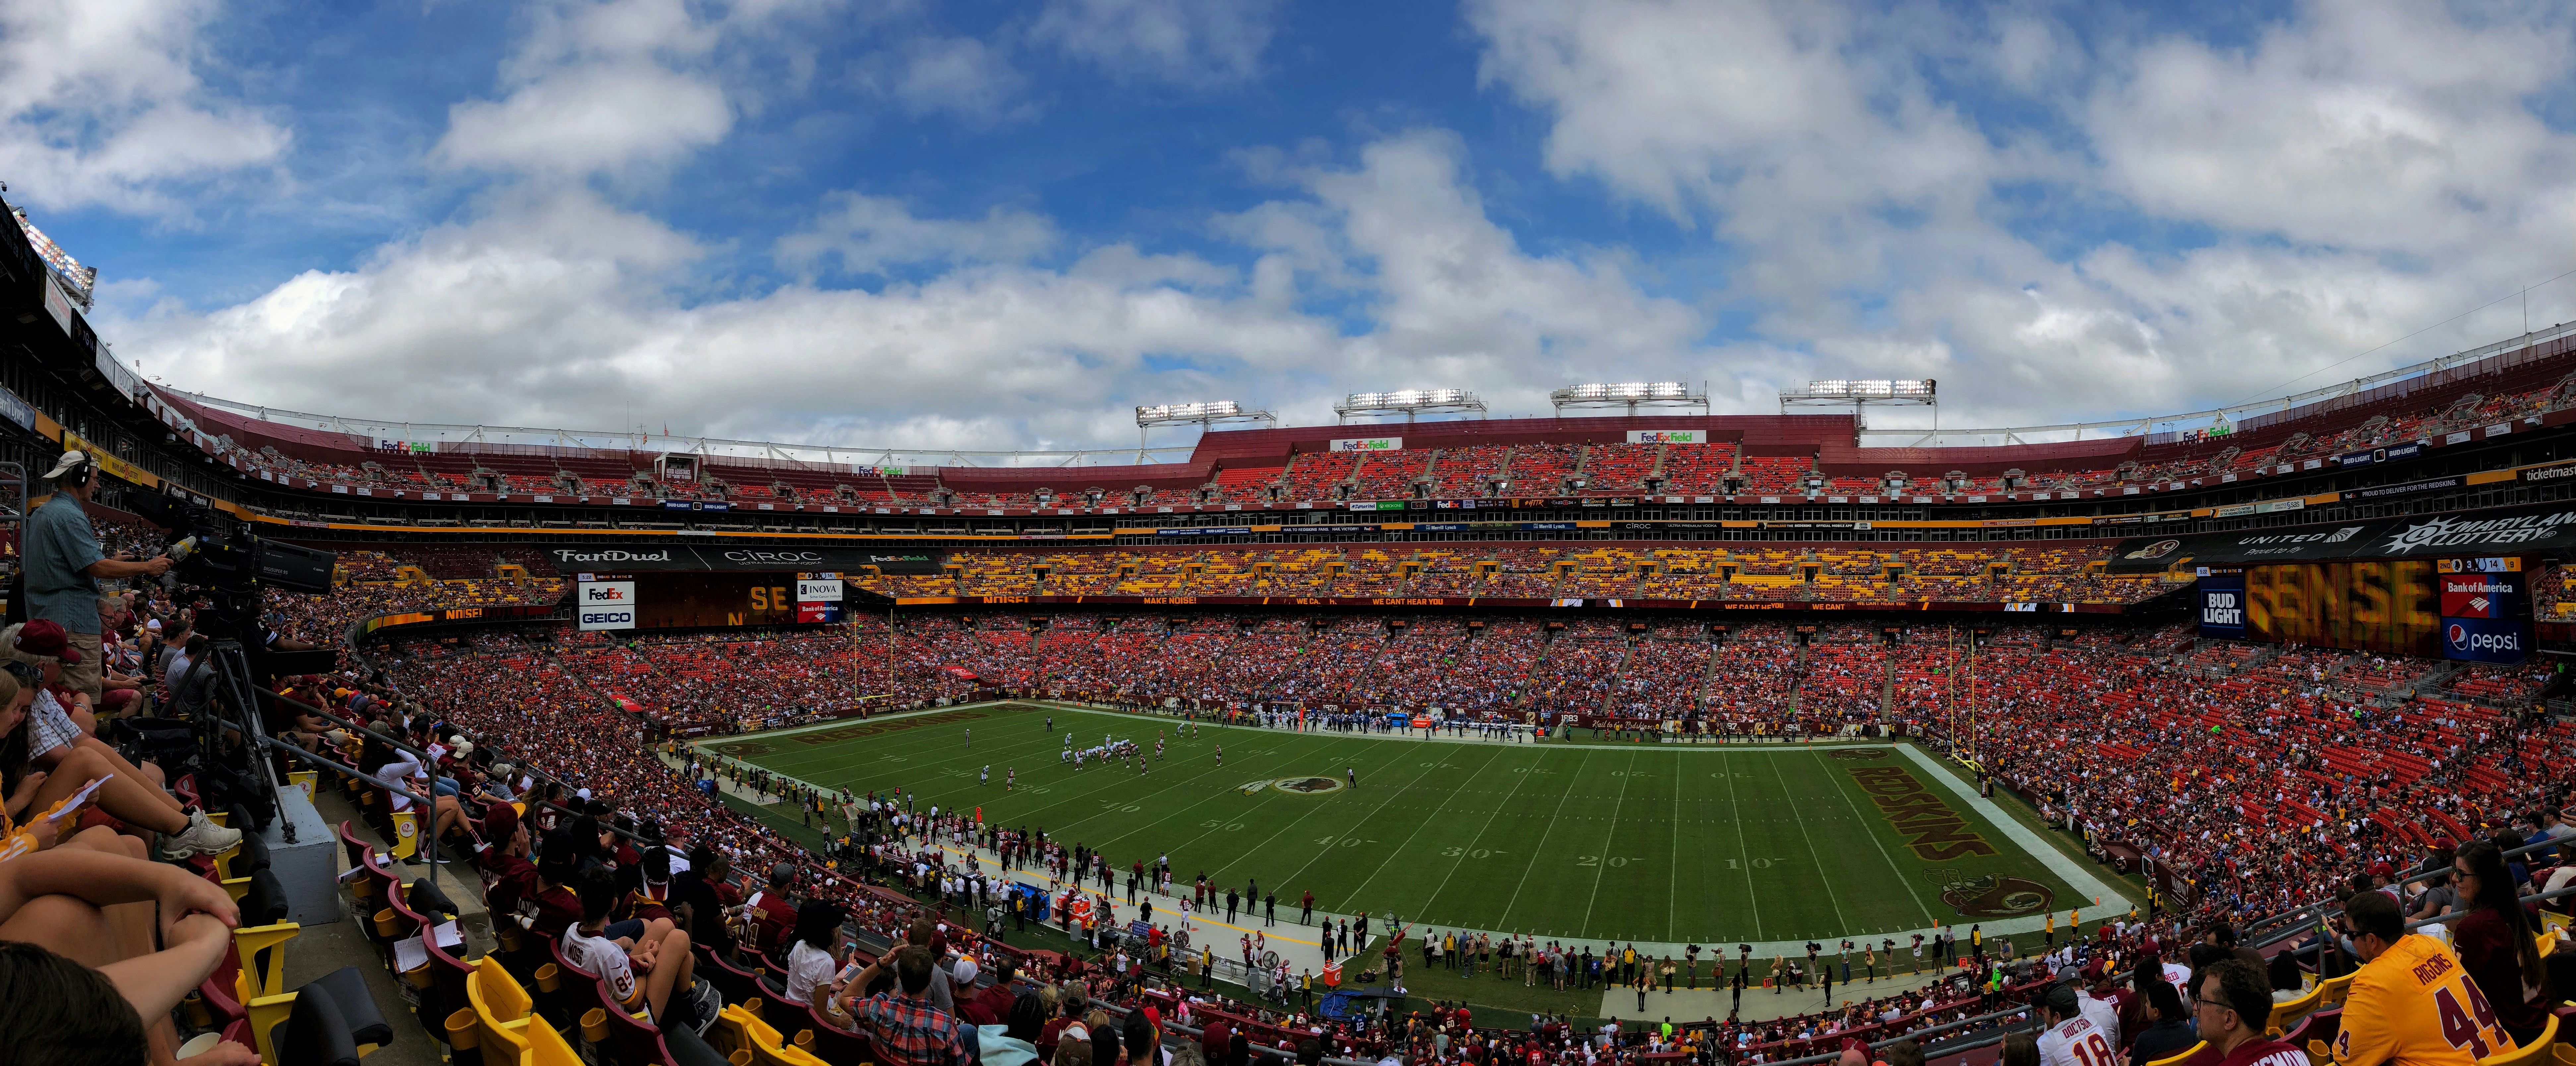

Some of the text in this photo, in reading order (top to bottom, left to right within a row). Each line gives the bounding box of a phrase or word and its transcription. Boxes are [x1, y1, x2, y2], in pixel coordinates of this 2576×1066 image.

[47, 281, 70, 321] At Eastern
[96, 346, 113, 377] RE/MAX
[120, 371, 130, 392] BDO
[0, 398, 24, 423] errill Lynch
[1641, 432, 1692, 441] FedExField
[2184, 425, 2229, 441] FedExField
[1343, 440, 1388, 450] FedExField
[2401, 446, 2418, 455] LIGHT
[112, 462, 139, 479] MARYLAND LOTTERY
[859, 466, 902, 475] FedExField
[2429, 479, 2457, 488] REDSKINS.
[174, 487, 186, 499] Ameritel
[195, 495, 207, 506] Ameritel
[2454, 511, 2576, 533] MARYLAN
[2239, 533, 2326, 544] UNITED
[2431, 526, 2556, 546] LOTTERY
[553, 549, 672, 562] FanDuel
[2448, 582, 2512, 592] Bank of America
[589, 588, 623, 600] FedEx
[2208, 593, 2235, 608] BUD
[446, 608, 482, 619] NOISE!
[582, 612, 630, 624] GEICO
[2204, 608, 2241, 624] LIGHT
[2472, 632, 2516, 653] pepsi
[789, 711, 991, 745] REDSKINS
[1592, 720, 1605, 729] Hail
[1101, 802, 1140, 812] 40
[1845, 766, 2002, 861] REDSKINS
[1200, 819, 1244, 831] 50
[1313, 836, 1361, 847] 40
[1441, 846, 1490, 858] 30
[1576, 855, 1627, 867] 20
[1725, 858, 1771, 869] 10
[2171, 875, 2188, 900] WOW!
[517, 896, 539, 921] TAYLOR
[746, 903, 768, 921] ERRIGAN
[568, 942, 583, 966] MOSS
[1275, 970, 1283, 980] 37
[2412, 953, 2453, 986] RIGGINS
[615, 969, 632, 992] 89
[2165, 971, 2180, 982] REED
[1765, 979, 1772, 987] 10
[1447, 1019, 1455, 1028] 60
[2433, 974, 2509, 1062] 44
[1356, 1022, 1364, 1032] 12
[2062, 1018, 2092, 1039] DOCTSON
[2072, 1032, 2116, 1066] 18
